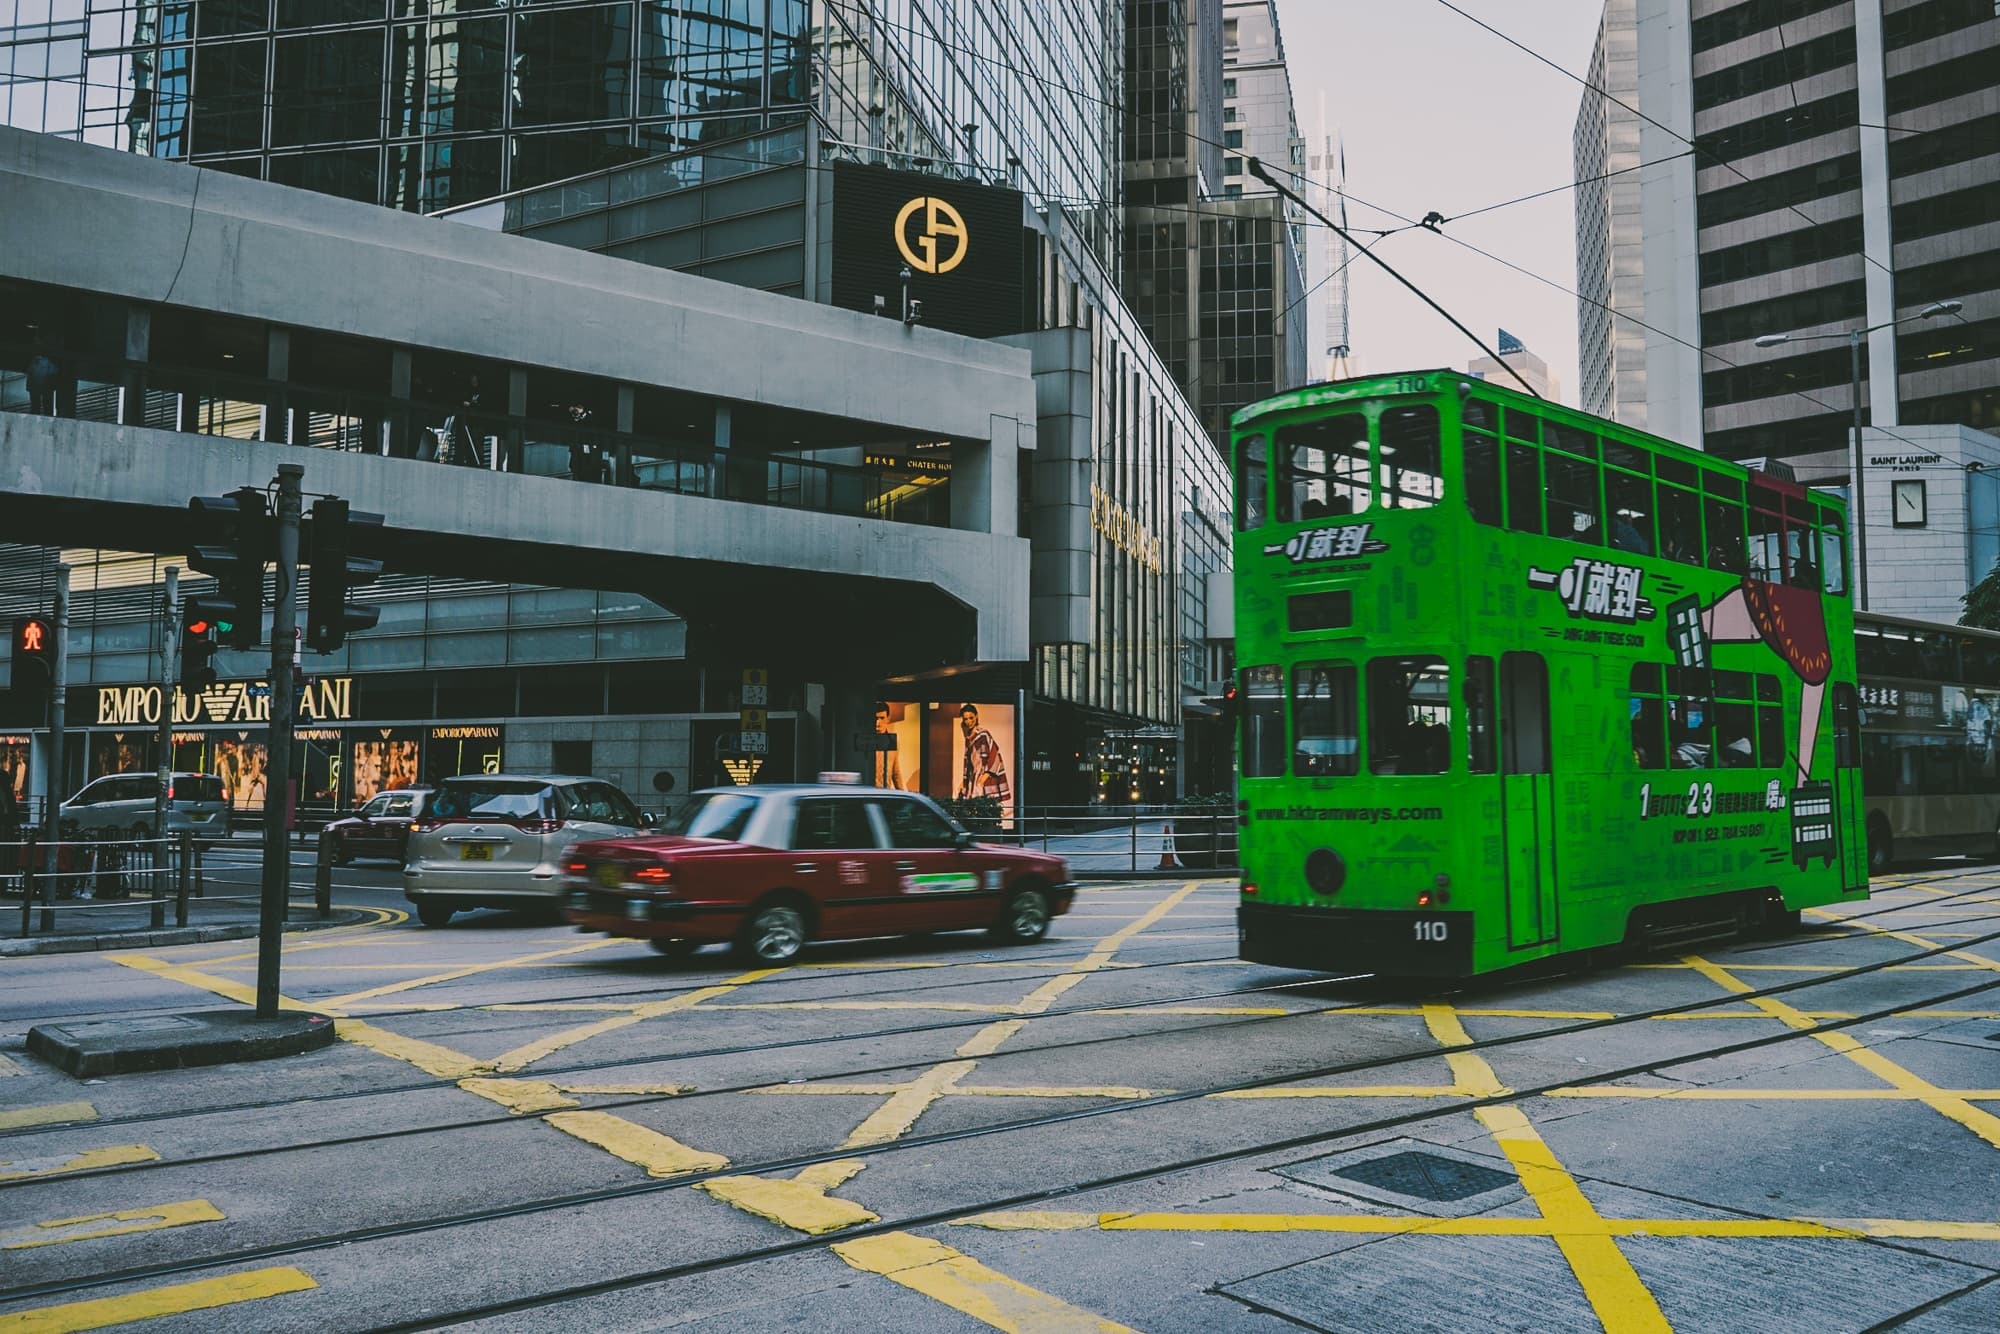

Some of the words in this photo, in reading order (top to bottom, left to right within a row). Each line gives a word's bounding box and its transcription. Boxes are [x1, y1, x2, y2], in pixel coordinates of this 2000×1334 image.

[1394, 377, 1427, 392] 110
[907, 460, 936, 469] CHATER
[1870, 456, 1897, 465] SAINT
[1899, 455, 1942, 464] LAURENT
[232, 678, 352, 721] ARANI
[1255, 804, 1443, 825] www.hktramways.com
[1413, 921, 1448, 941] 110
